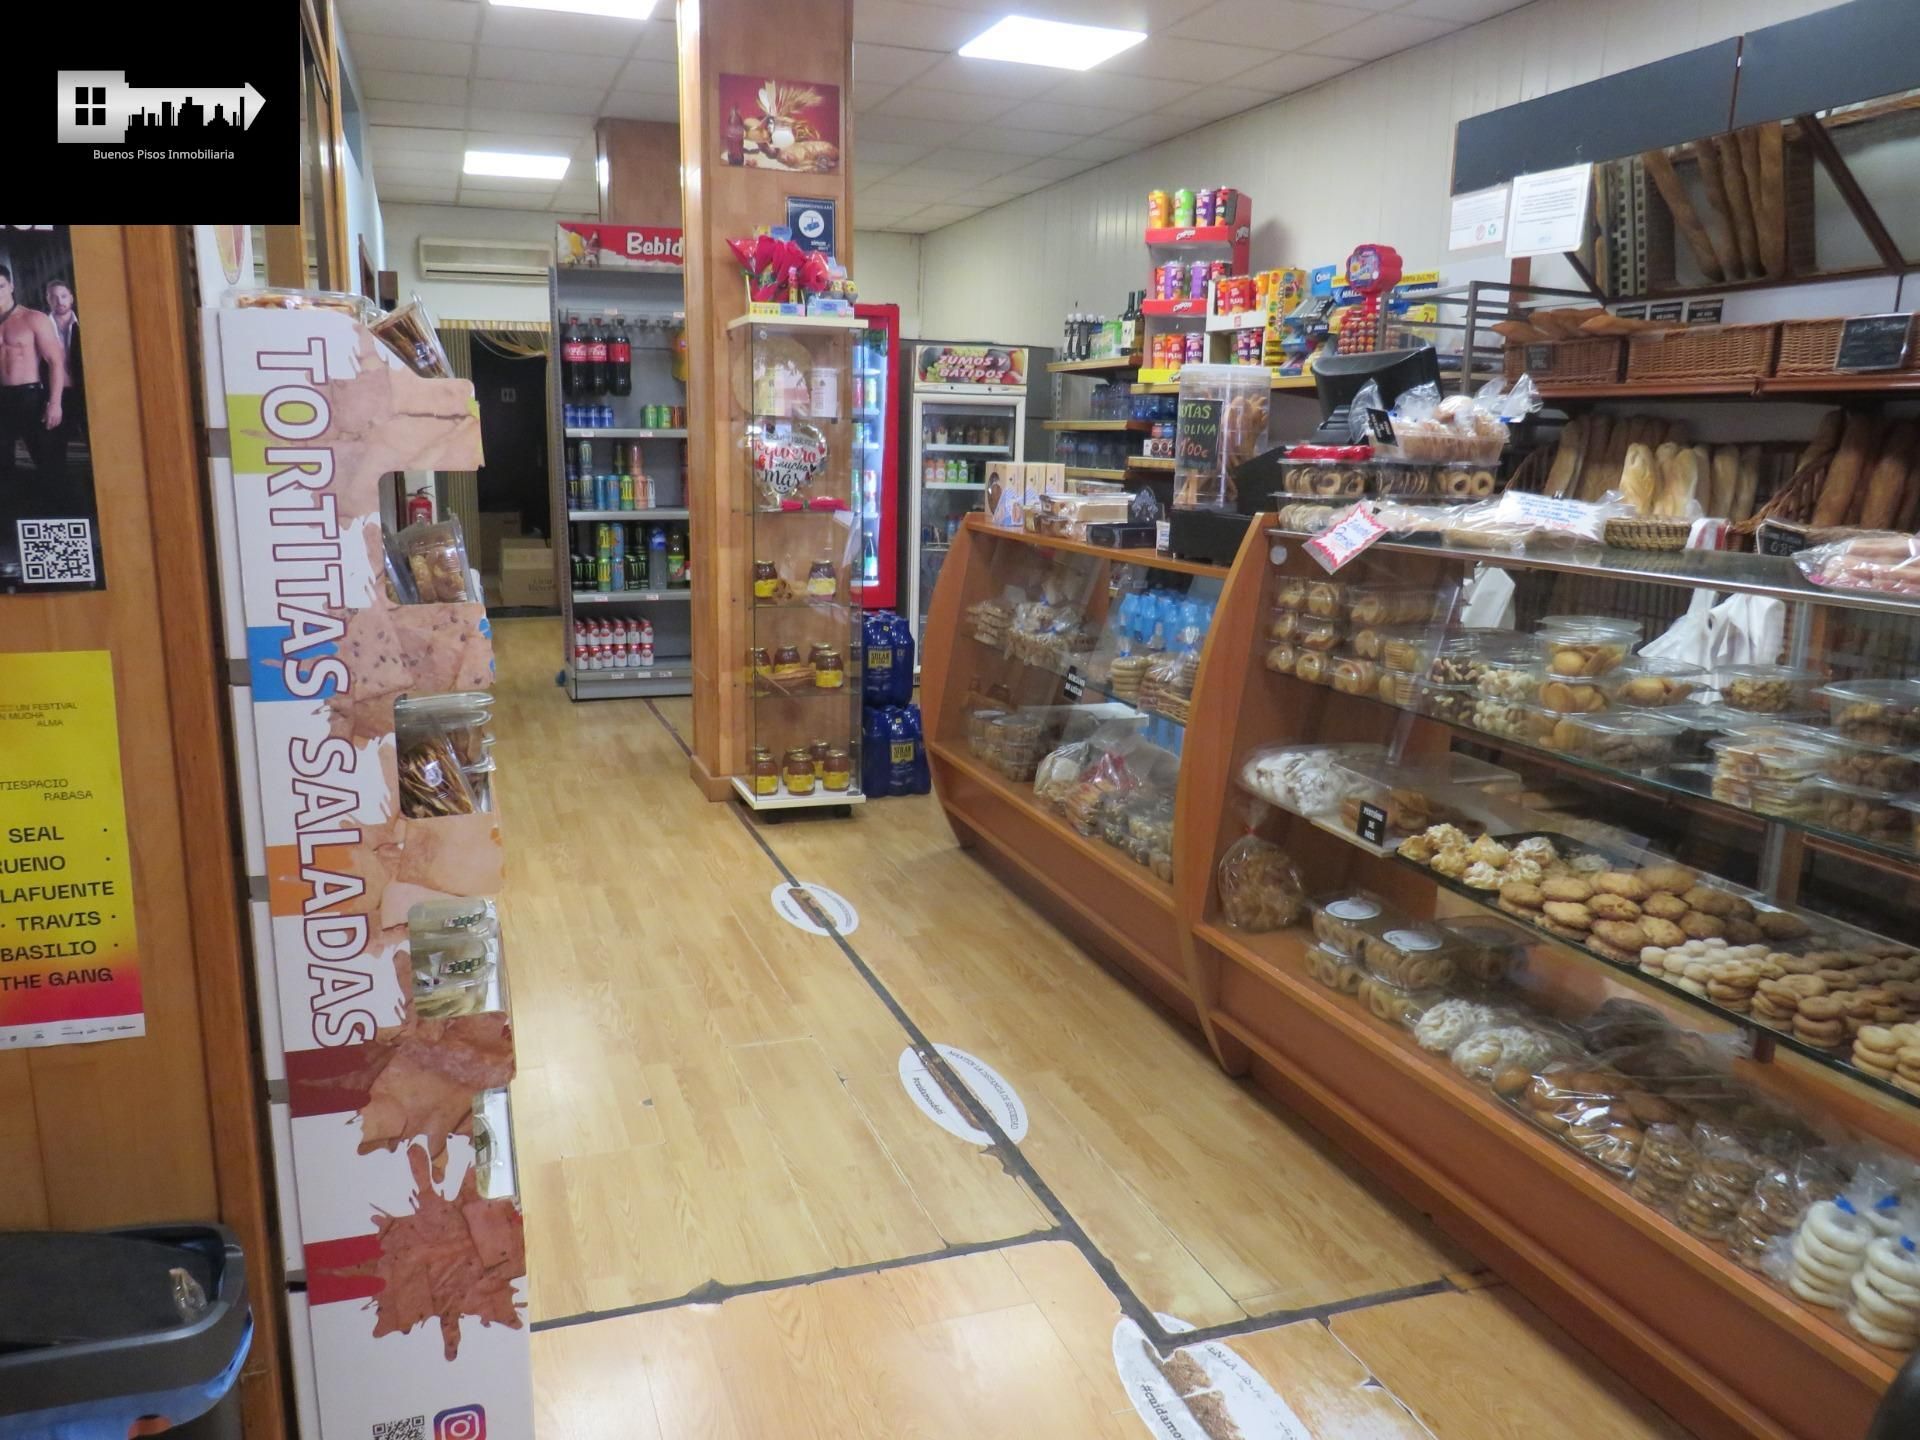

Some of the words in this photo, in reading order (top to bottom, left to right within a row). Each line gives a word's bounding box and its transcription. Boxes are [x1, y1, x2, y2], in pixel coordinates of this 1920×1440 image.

[938, 355, 994, 366] ZUMOS
[997, 357, 1007, 366] Y
[939, 368, 1006, 379] BATIDOS
[1184, 423, 1217, 436] OLIVA
[256, 336, 349, 698] TORTITAS
[33, 702, 78, 711] FESTIVAL
[9, 711, 45, 720] MUCHA
[37, 719, 64, 727] ALMA
[44, 790, 94, 801] RABASA
[8, 826, 65, 843] SEAL
[0, 880, 115, 903] LAFUENTE
[288, 737, 377, 1047] SALADAS
[16, 911, 102, 932] TRAVIS
[1, 940, 97, 963] BASILIO
[0, 974, 42, 991] THE
[48, 967, 114, 987] GANG
